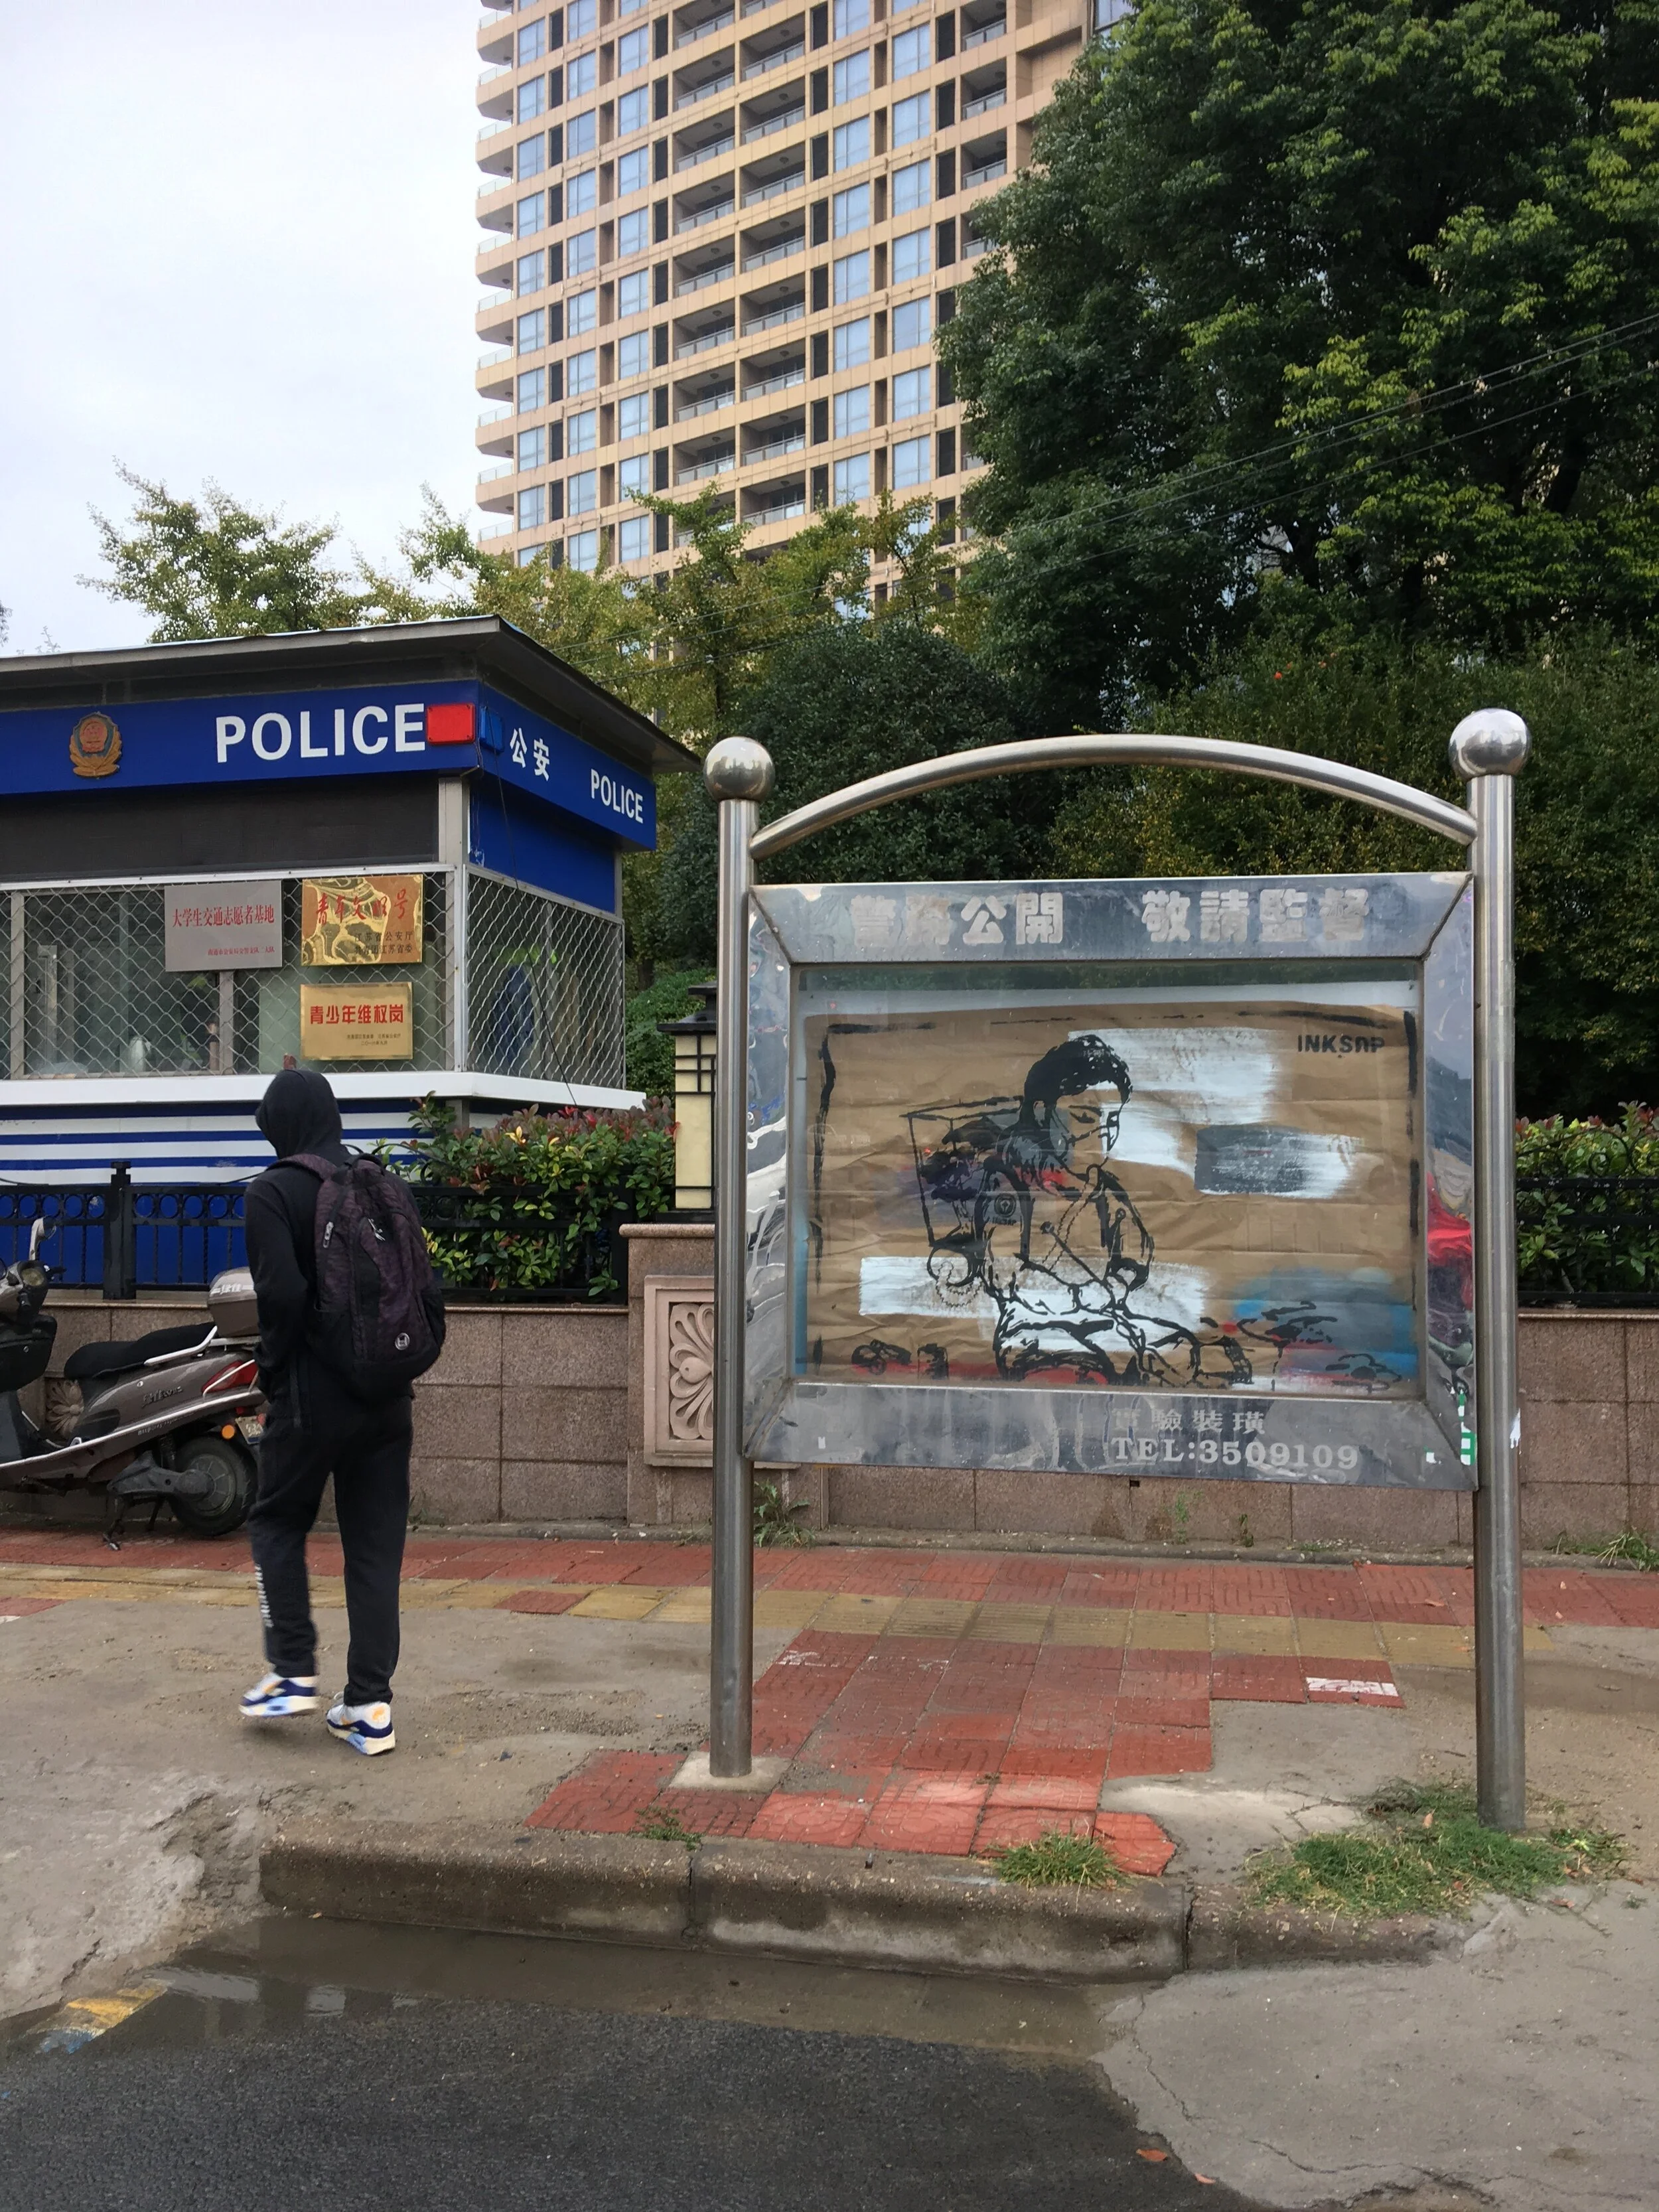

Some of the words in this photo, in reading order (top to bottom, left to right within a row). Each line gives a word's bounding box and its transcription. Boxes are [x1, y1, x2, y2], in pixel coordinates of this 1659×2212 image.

[216, 703, 425, 763] POLICE
[509, 727, 550, 781] 公安
[590, 768, 644, 824] POLICE
[173, 904, 275, 927] 大学生交通志愿者基地
[1142, 889, 1370, 943] 敬請監督
[310, 1003, 403, 1024] 青少年维权岗
[1111, 1437, 1358, 1470] TEL:3509109
